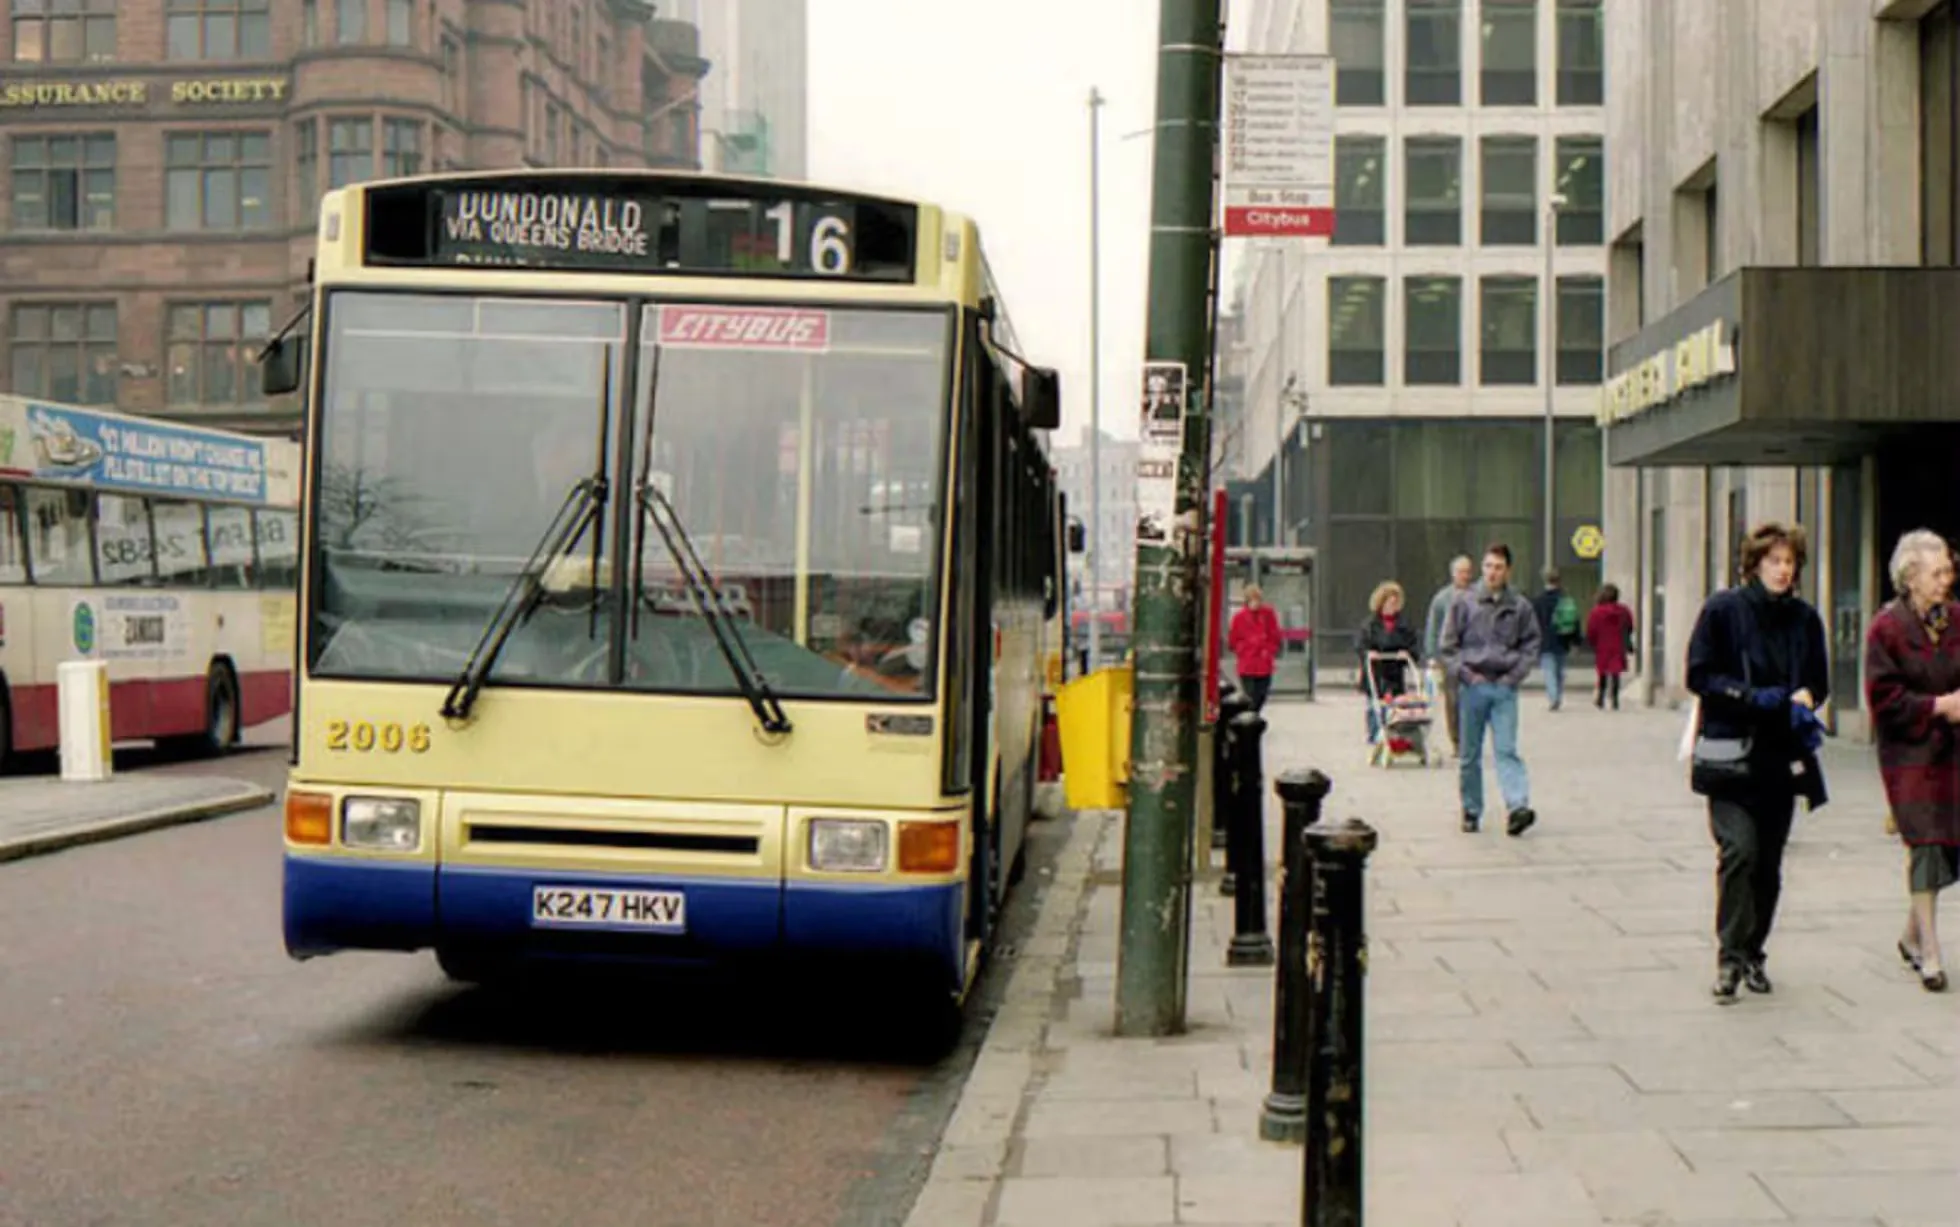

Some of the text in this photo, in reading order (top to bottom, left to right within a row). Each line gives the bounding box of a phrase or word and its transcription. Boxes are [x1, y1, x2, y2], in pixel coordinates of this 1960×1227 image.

[0, 78, 286, 105] SSURANCE SOCIETY
[1248, 189, 1310, 206] Bus Stop
[1246, 209, 1311, 230] Citybus
[447, 215, 649, 256] VIA QUEENS BRIDGE
[765, 202, 850, 275] 16
[671, 313, 819, 342] CITYBUS
[326, 718, 431, 754] 2006
[536, 890, 681, 922] K247 HKV
